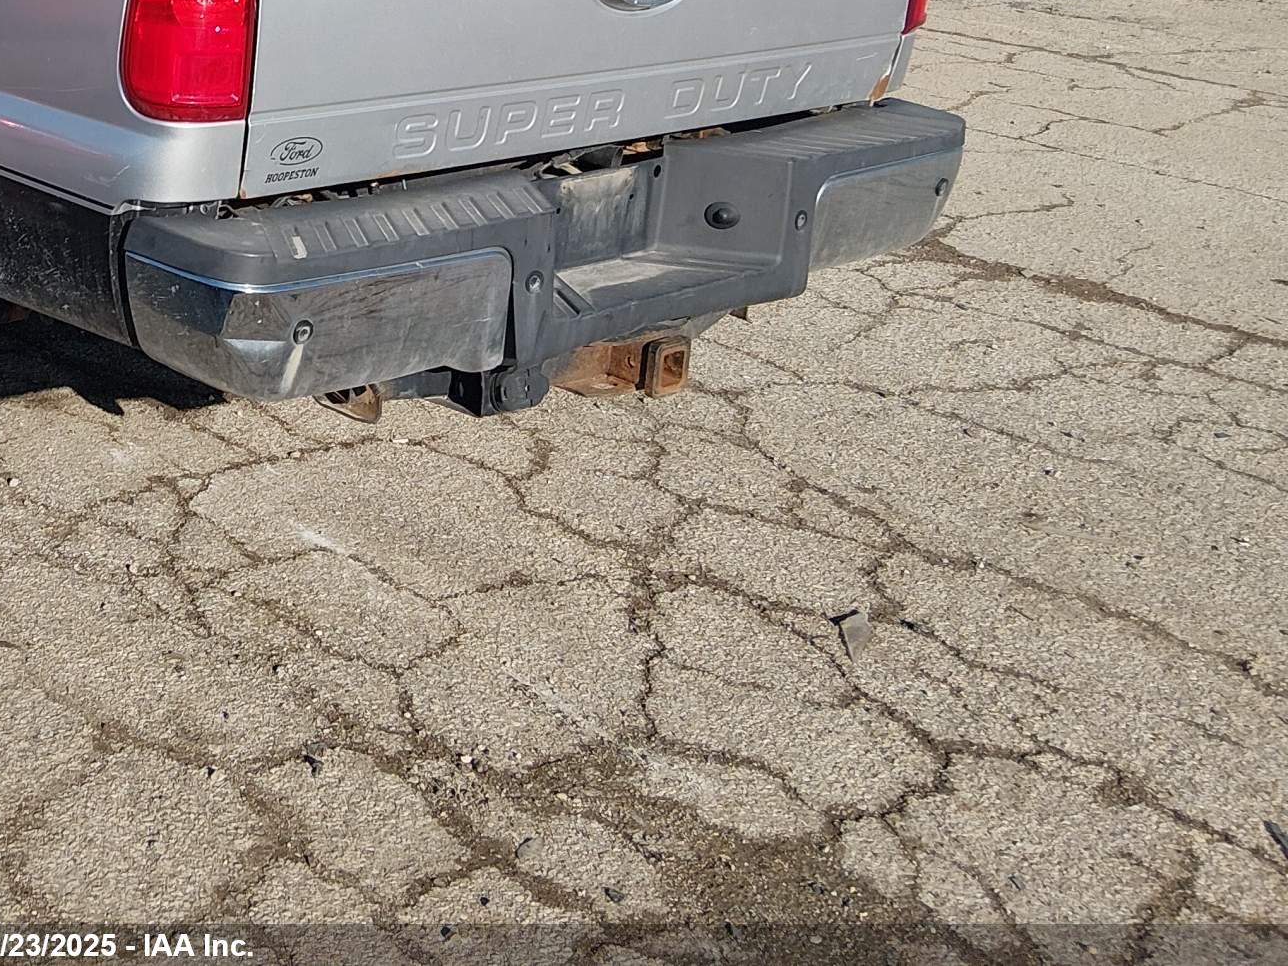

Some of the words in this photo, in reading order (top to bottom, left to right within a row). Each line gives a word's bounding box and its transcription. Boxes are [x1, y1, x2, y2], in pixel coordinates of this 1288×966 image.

[391, 88, 626, 160] SUPER
[663, 62, 814, 121] DUTY
[279, 140, 315, 162] Ford
[264, 166, 320, 184] HOOPESTON
